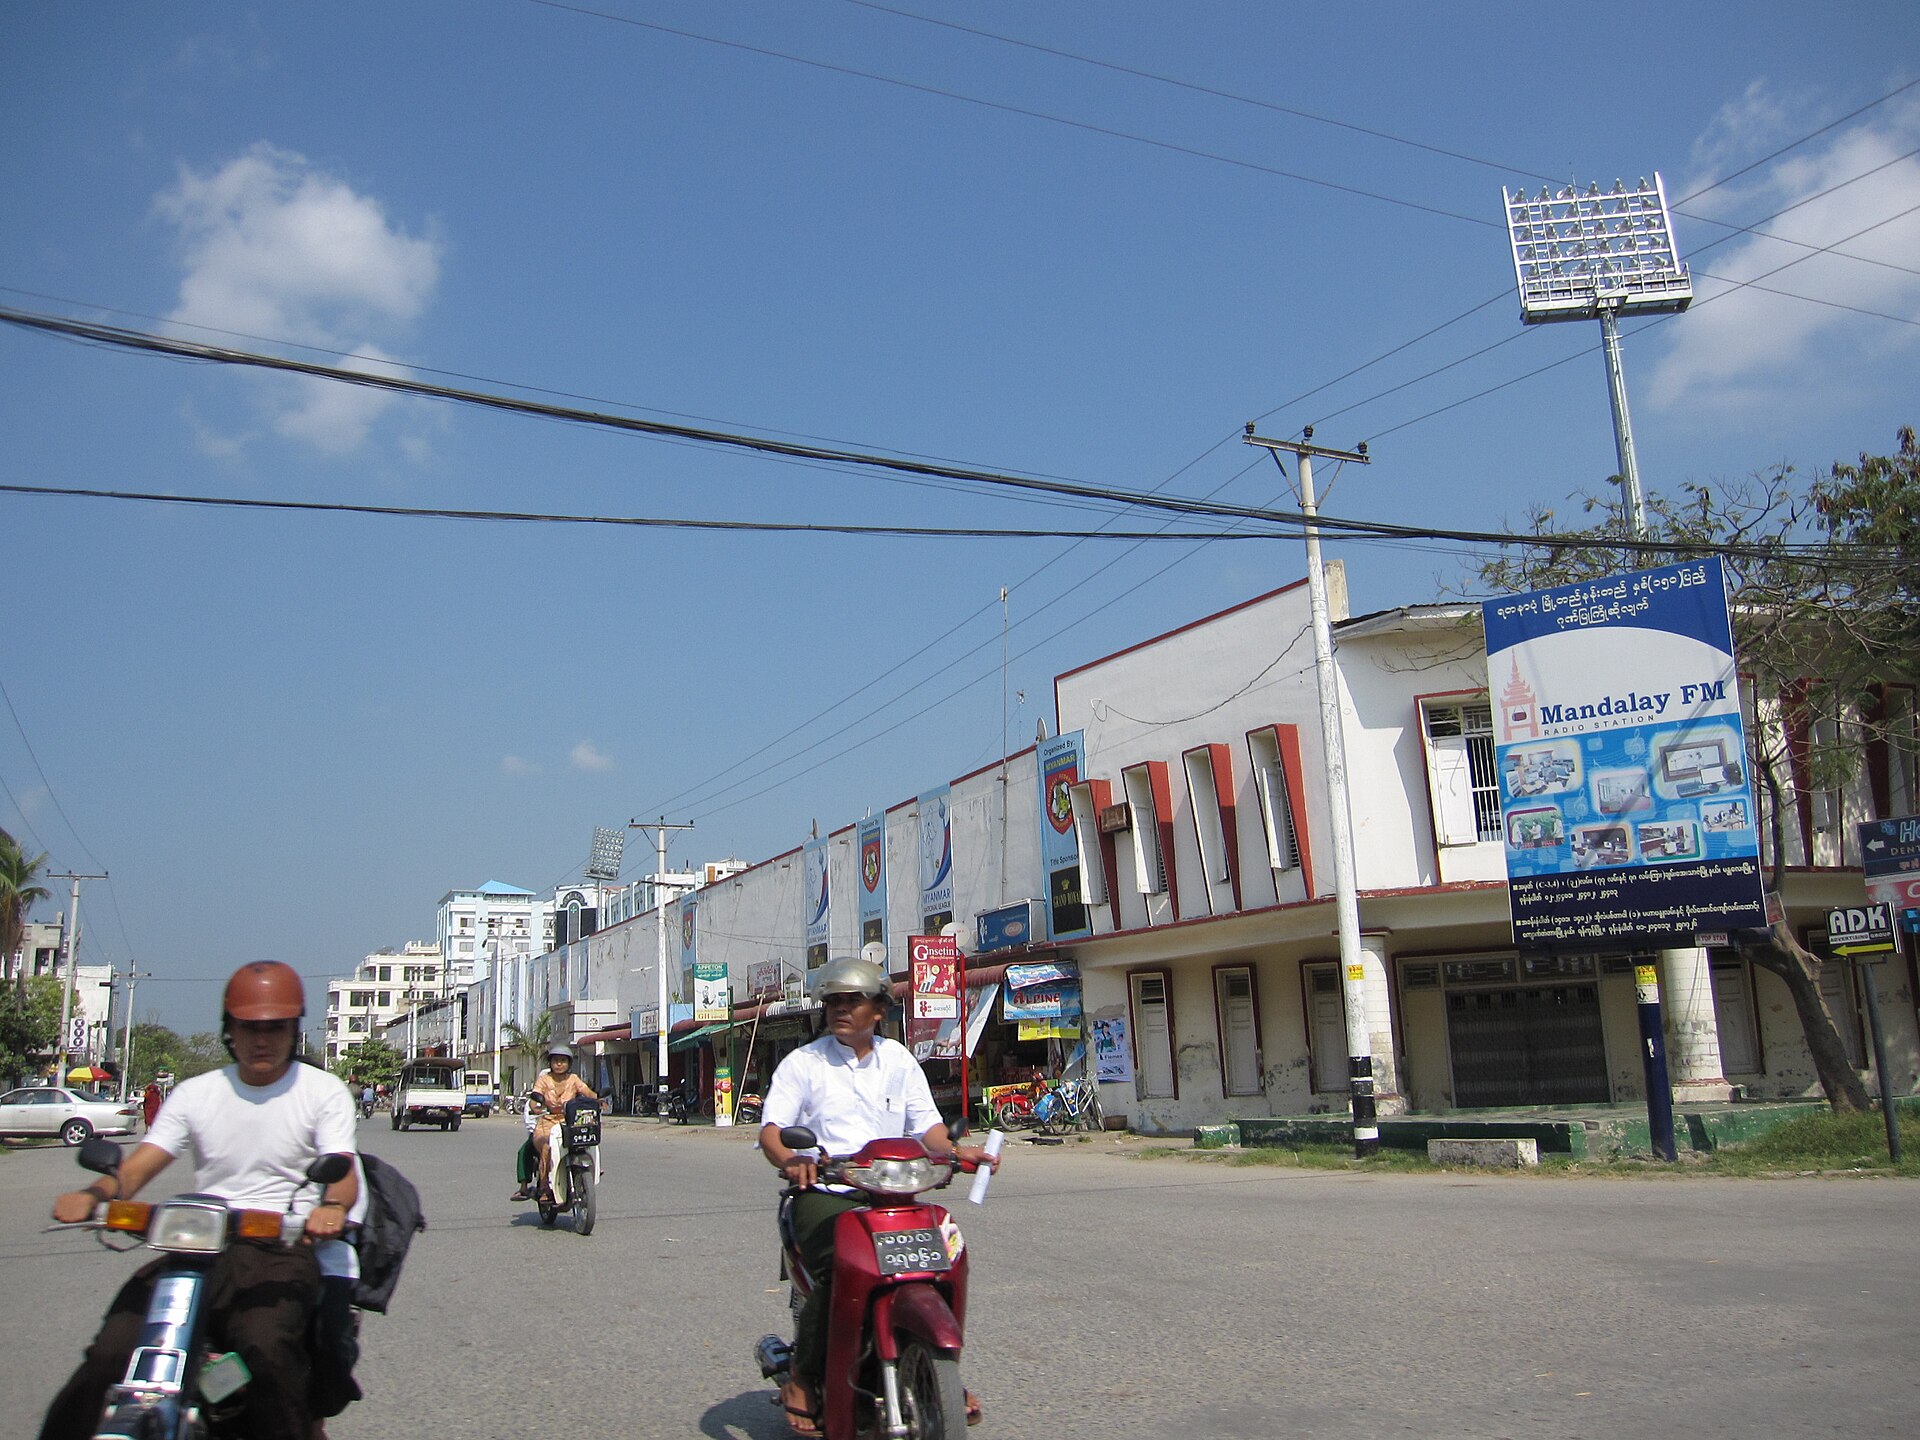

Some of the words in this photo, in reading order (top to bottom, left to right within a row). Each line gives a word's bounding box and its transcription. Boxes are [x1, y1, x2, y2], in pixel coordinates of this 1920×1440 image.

[1540, 692, 1670, 725] Mandalay
[1680, 680, 1726, 704] FM
[1544, 724, 1585, 736] RADIO
[1594, 714, 1654, 729] STATION
[1044, 742, 1066, 756] Organized
[1046, 754, 1076, 772] MYANMAR
[923, 888, 950, 904] MYANMAR
[1830, 906, 1886, 934] ADK
[1014, 990, 1061, 1005] ALPINE
